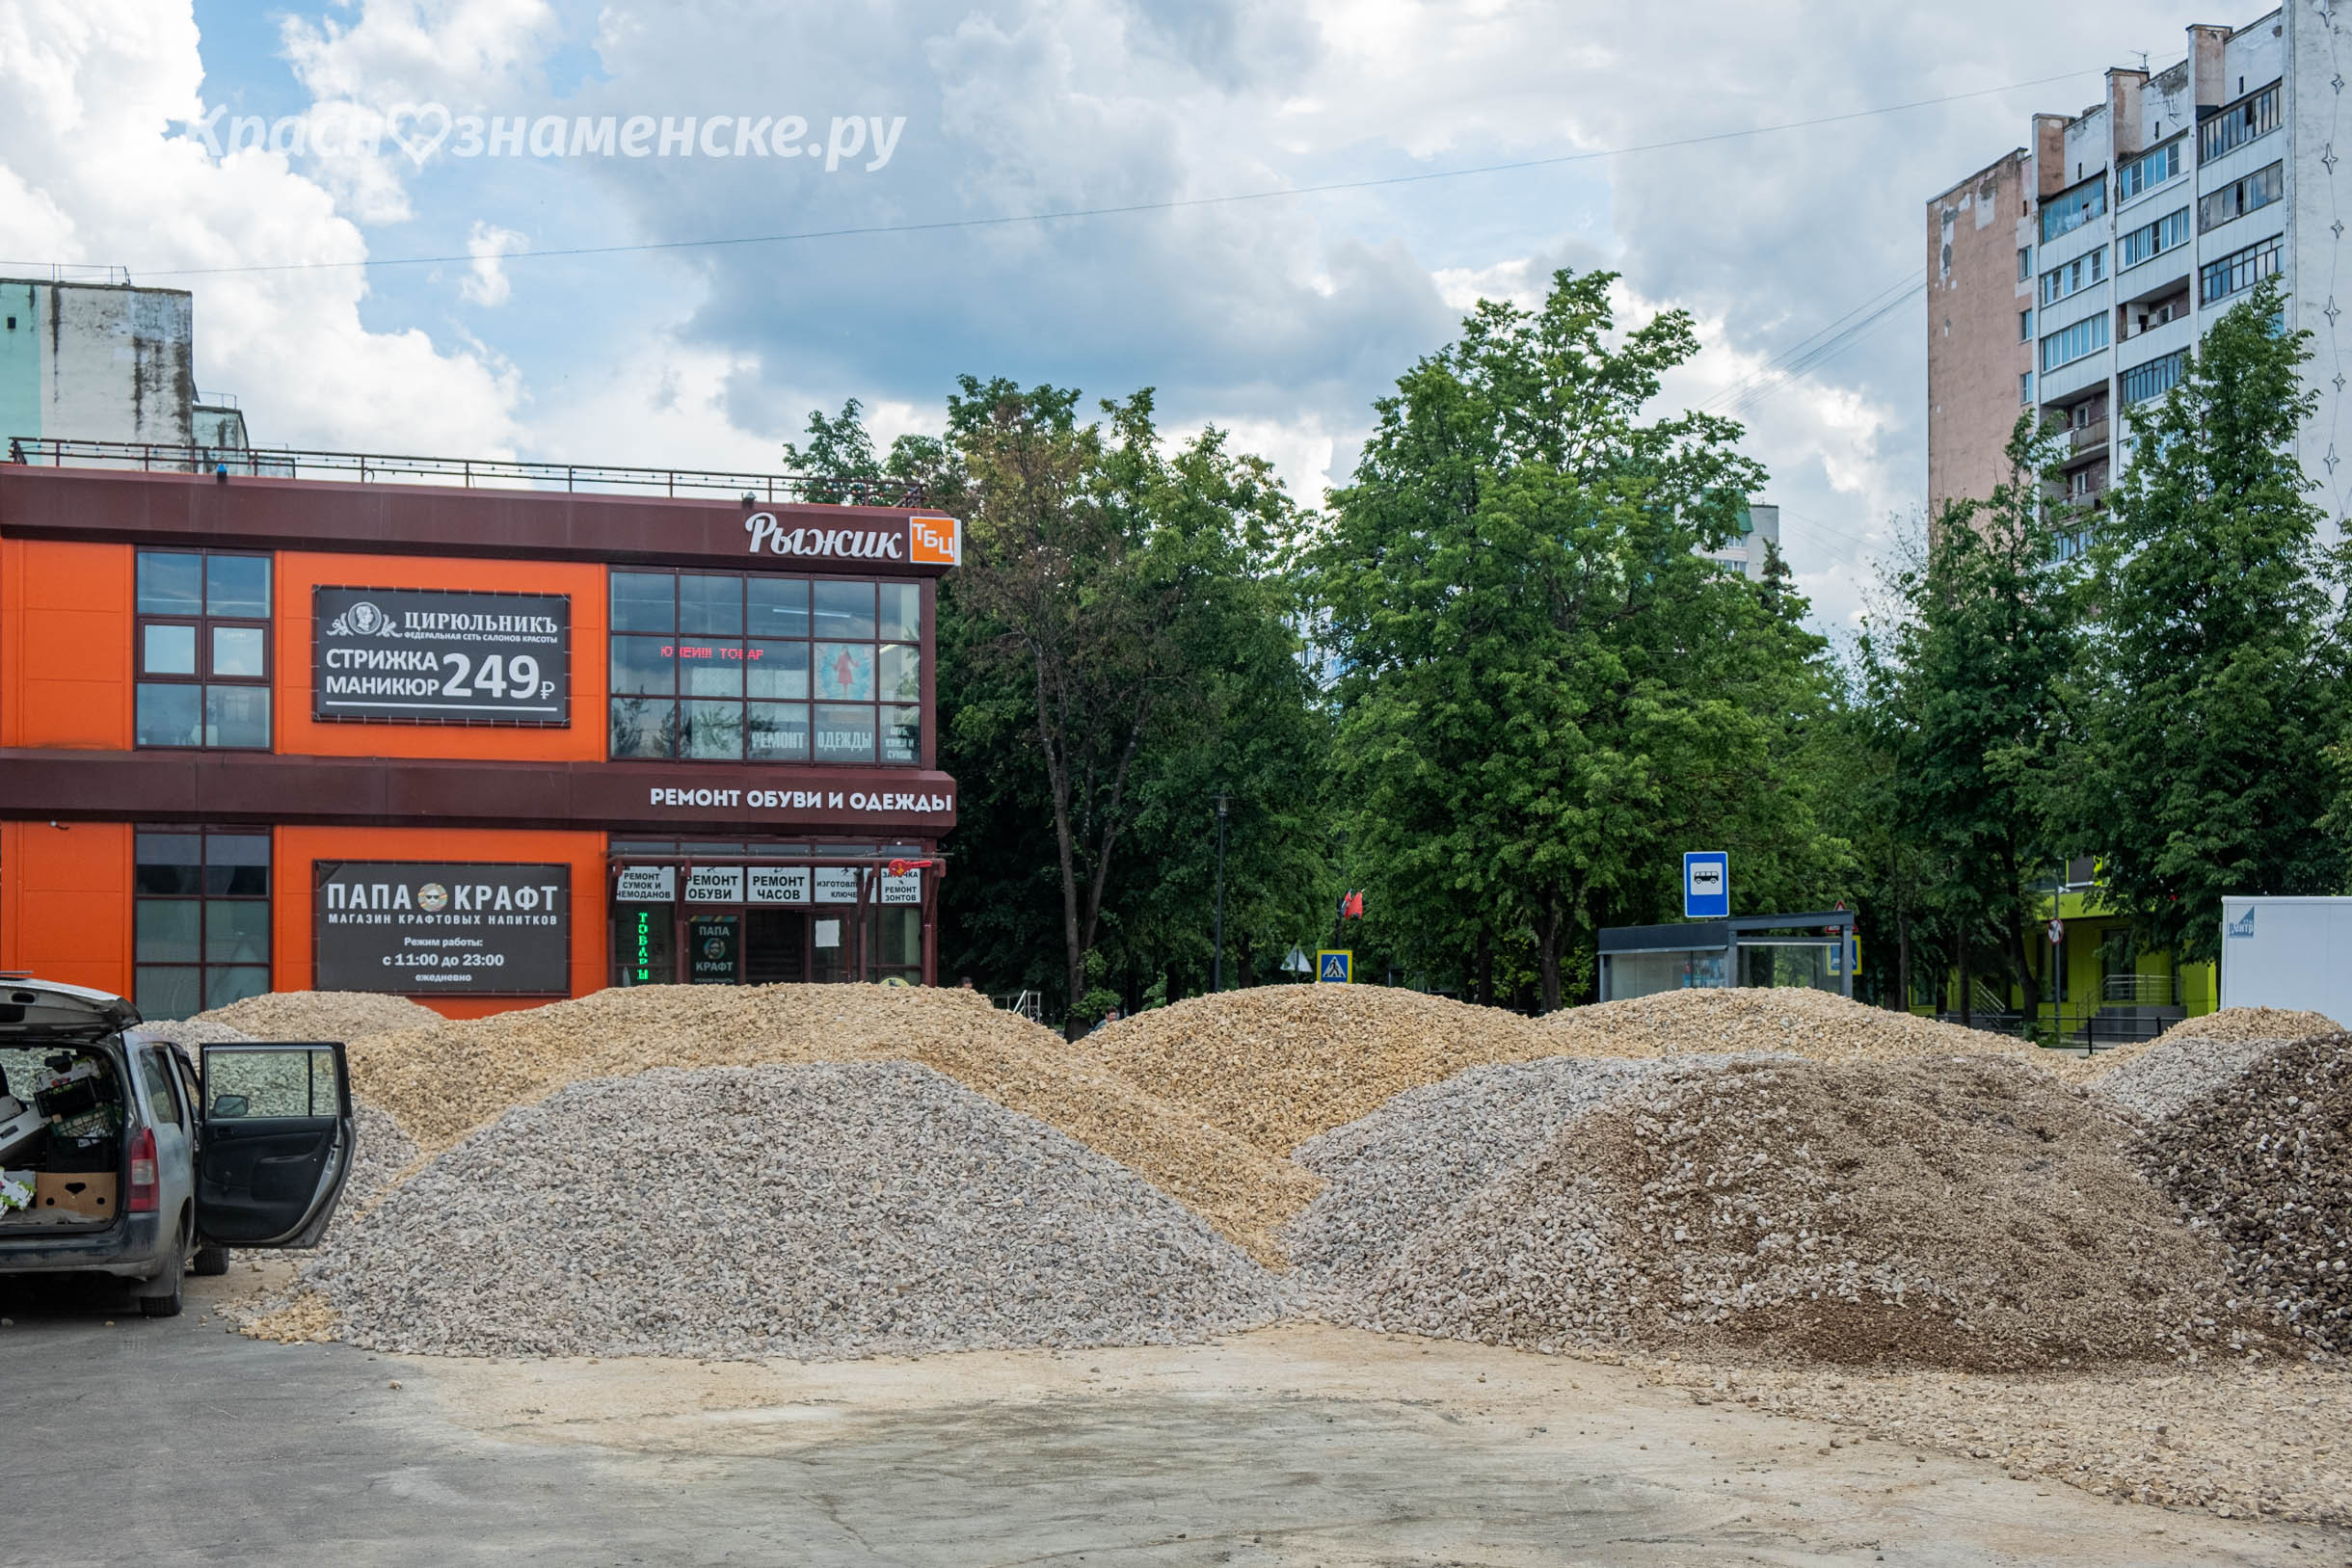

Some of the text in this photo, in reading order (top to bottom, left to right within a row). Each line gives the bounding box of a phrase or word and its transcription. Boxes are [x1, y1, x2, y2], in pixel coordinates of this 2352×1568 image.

[745, 512, 902, 559] Рыжик
[913, 523, 955, 557] ТБЦ
[404, 611, 558, 633] ЦИРЮЛЬНИКЪ
[404, 631, 558, 644] ФЕДЕРАЛЬНАЯ СЕТЬ САЛОНОВ КРАСОТЫ
[326, 648, 440, 672] СТРИЖКА
[326, 676, 440, 696] МАНИКЮР
[751, 731, 872, 752] РЕМОНТ ОДЕЖДЫ
[650, 787, 952, 812] РЕМОНТ ОБУВИ И ОДЕЖДЫ
[624, 872, 660, 881] РЕМОНТ
[686, 875, 738, 887] РЕМОНТ
[752, 875, 806, 888] РЕМОНТ
[622, 881, 653, 890] СУМОК
[327, 883, 558, 911] ПАПА КРАФТ
[688, 889, 733, 900] ОБУВИ
[757, 889, 801, 901] ЧАСОВ
[328, 913, 558, 925] МАГАЗИН КРАФТОВЫХ НАПИТКОВ
[699, 925, 730, 936] ПАПА
[404, 937, 484, 948] Режим работы:
[382, 953, 504, 968] с 11:00 до 23:00
[695, 962, 734, 972] КРАФТ
[414, 972, 472, 982] ежедневно
